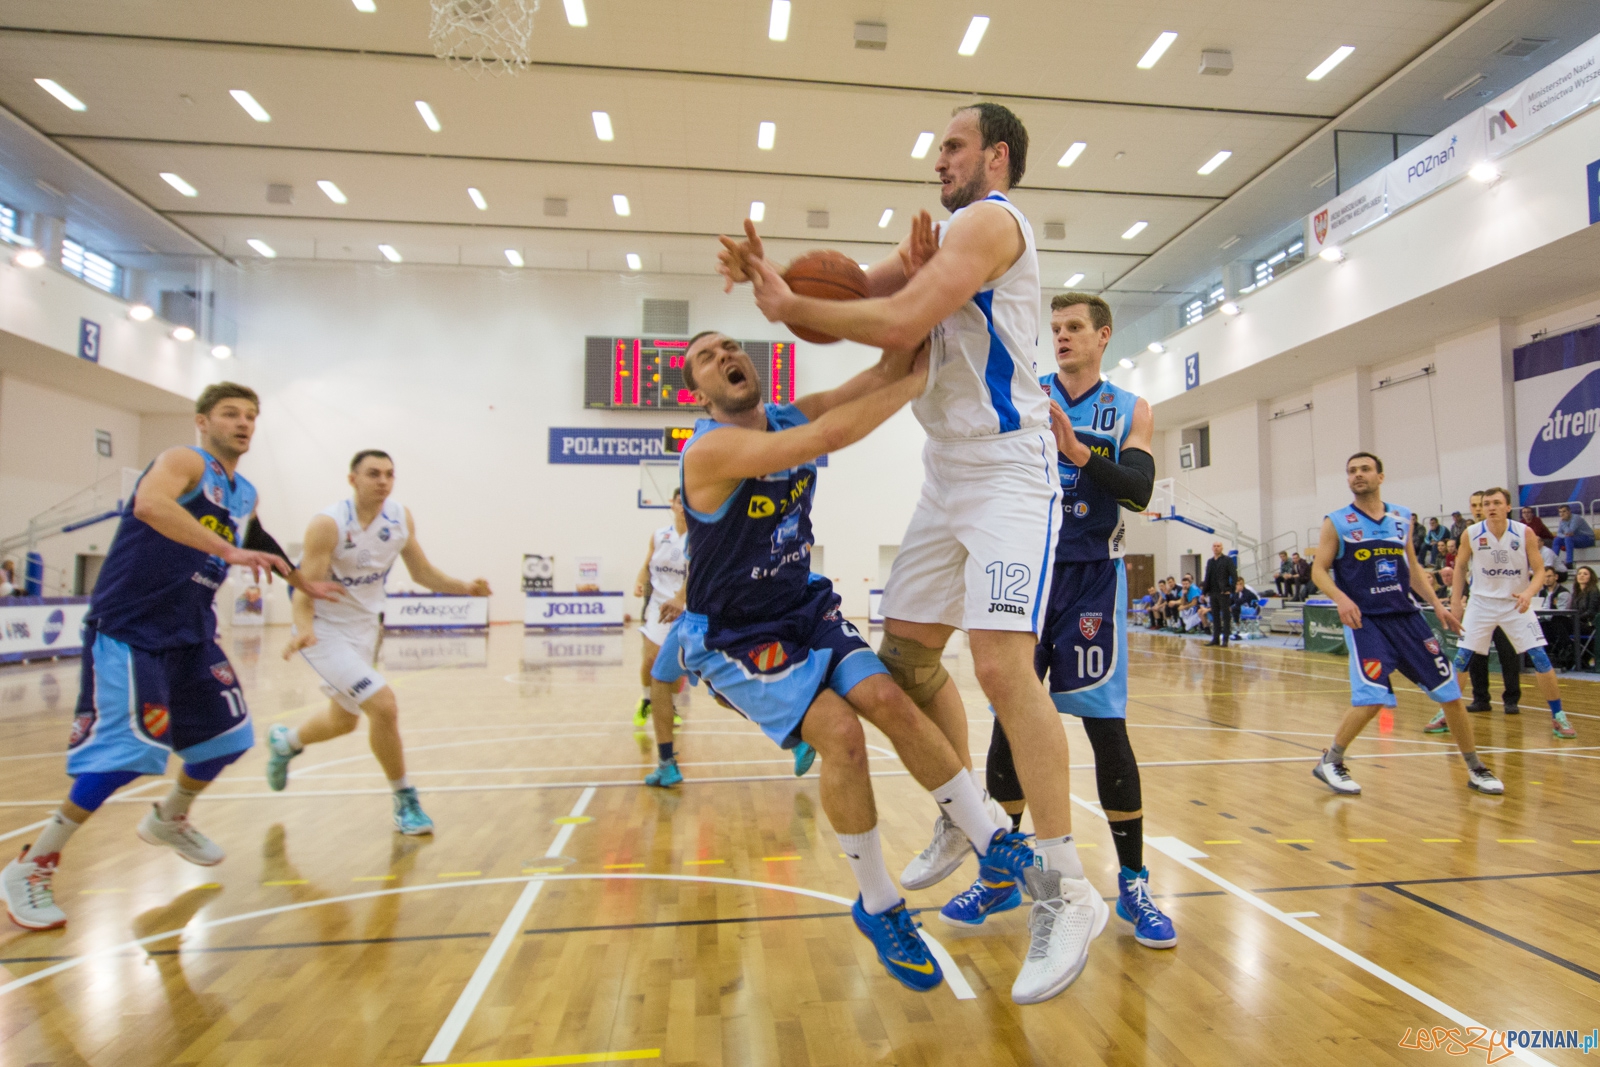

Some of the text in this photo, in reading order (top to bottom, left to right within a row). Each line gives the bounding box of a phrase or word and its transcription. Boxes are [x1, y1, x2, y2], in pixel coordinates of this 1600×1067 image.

[1528, 55, 1595, 103] Ministerstwo Nauki
[1531, 85, 1574, 114] Szkolnictwa
[83, 325, 98, 358] 3
[1187, 357, 1196, 386] 3
[1092, 403, 1117, 431] 10
[1395, 521, 1404, 540] 5
[1490, 549, 1509, 564] 16
[986, 561, 1031, 604] 12
[400, 602, 471, 616] rehasport
[1073, 645, 1104, 679] 10
[1434, 656, 1450, 677] 5
[220, 687, 246, 718] 11
